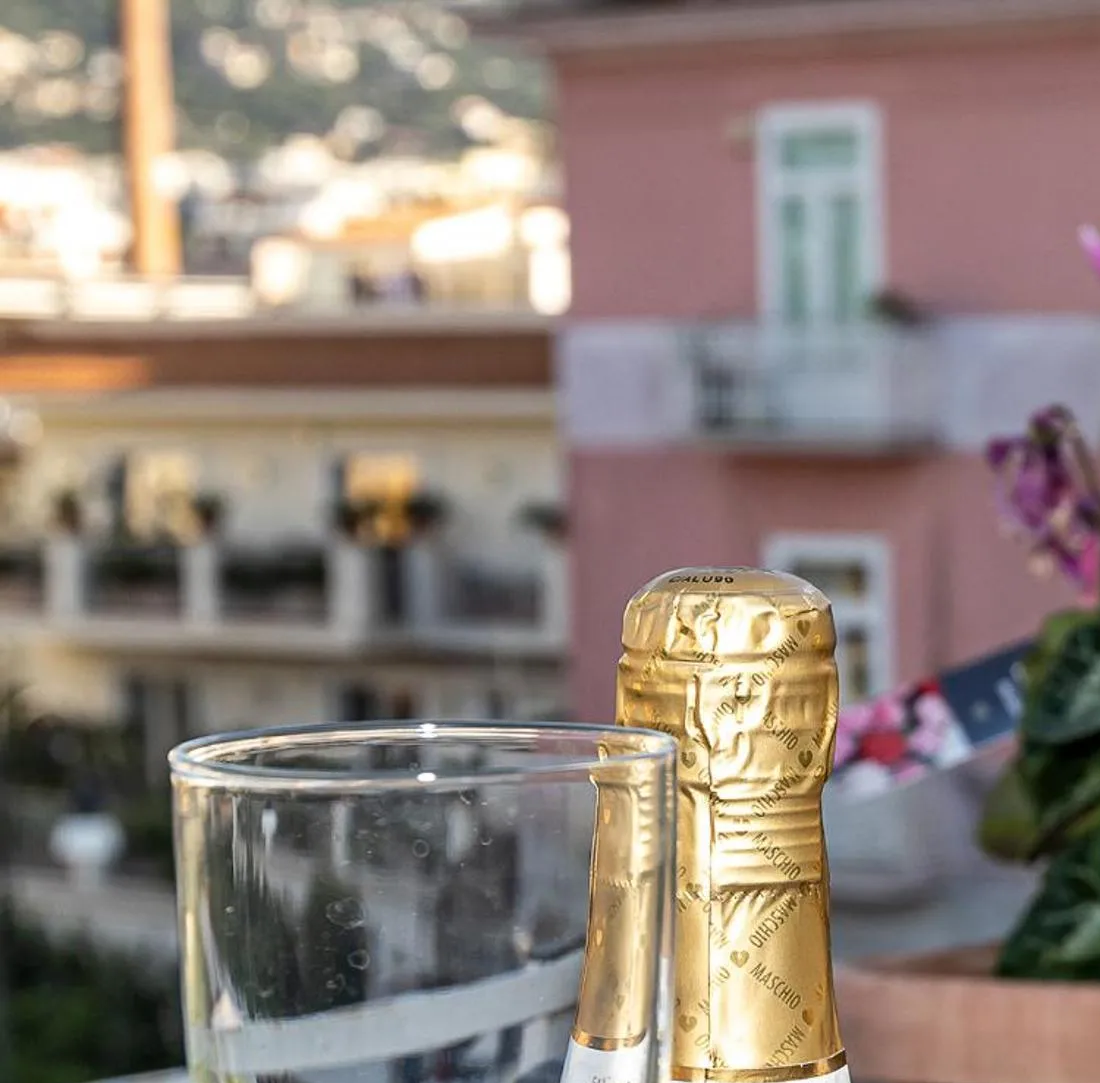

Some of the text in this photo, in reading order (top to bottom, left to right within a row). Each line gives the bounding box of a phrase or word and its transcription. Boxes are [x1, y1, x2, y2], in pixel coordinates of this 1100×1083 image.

[751, 635, 799, 687] MASCIO
[762, 710, 799, 750] ASHIO
[752, 831, 802, 881] MASCHIO
[749, 895, 799, 949] MASCHIO
[750, 963, 802, 1011] MASCHIO
[766, 1023, 806, 1067] MASCH
